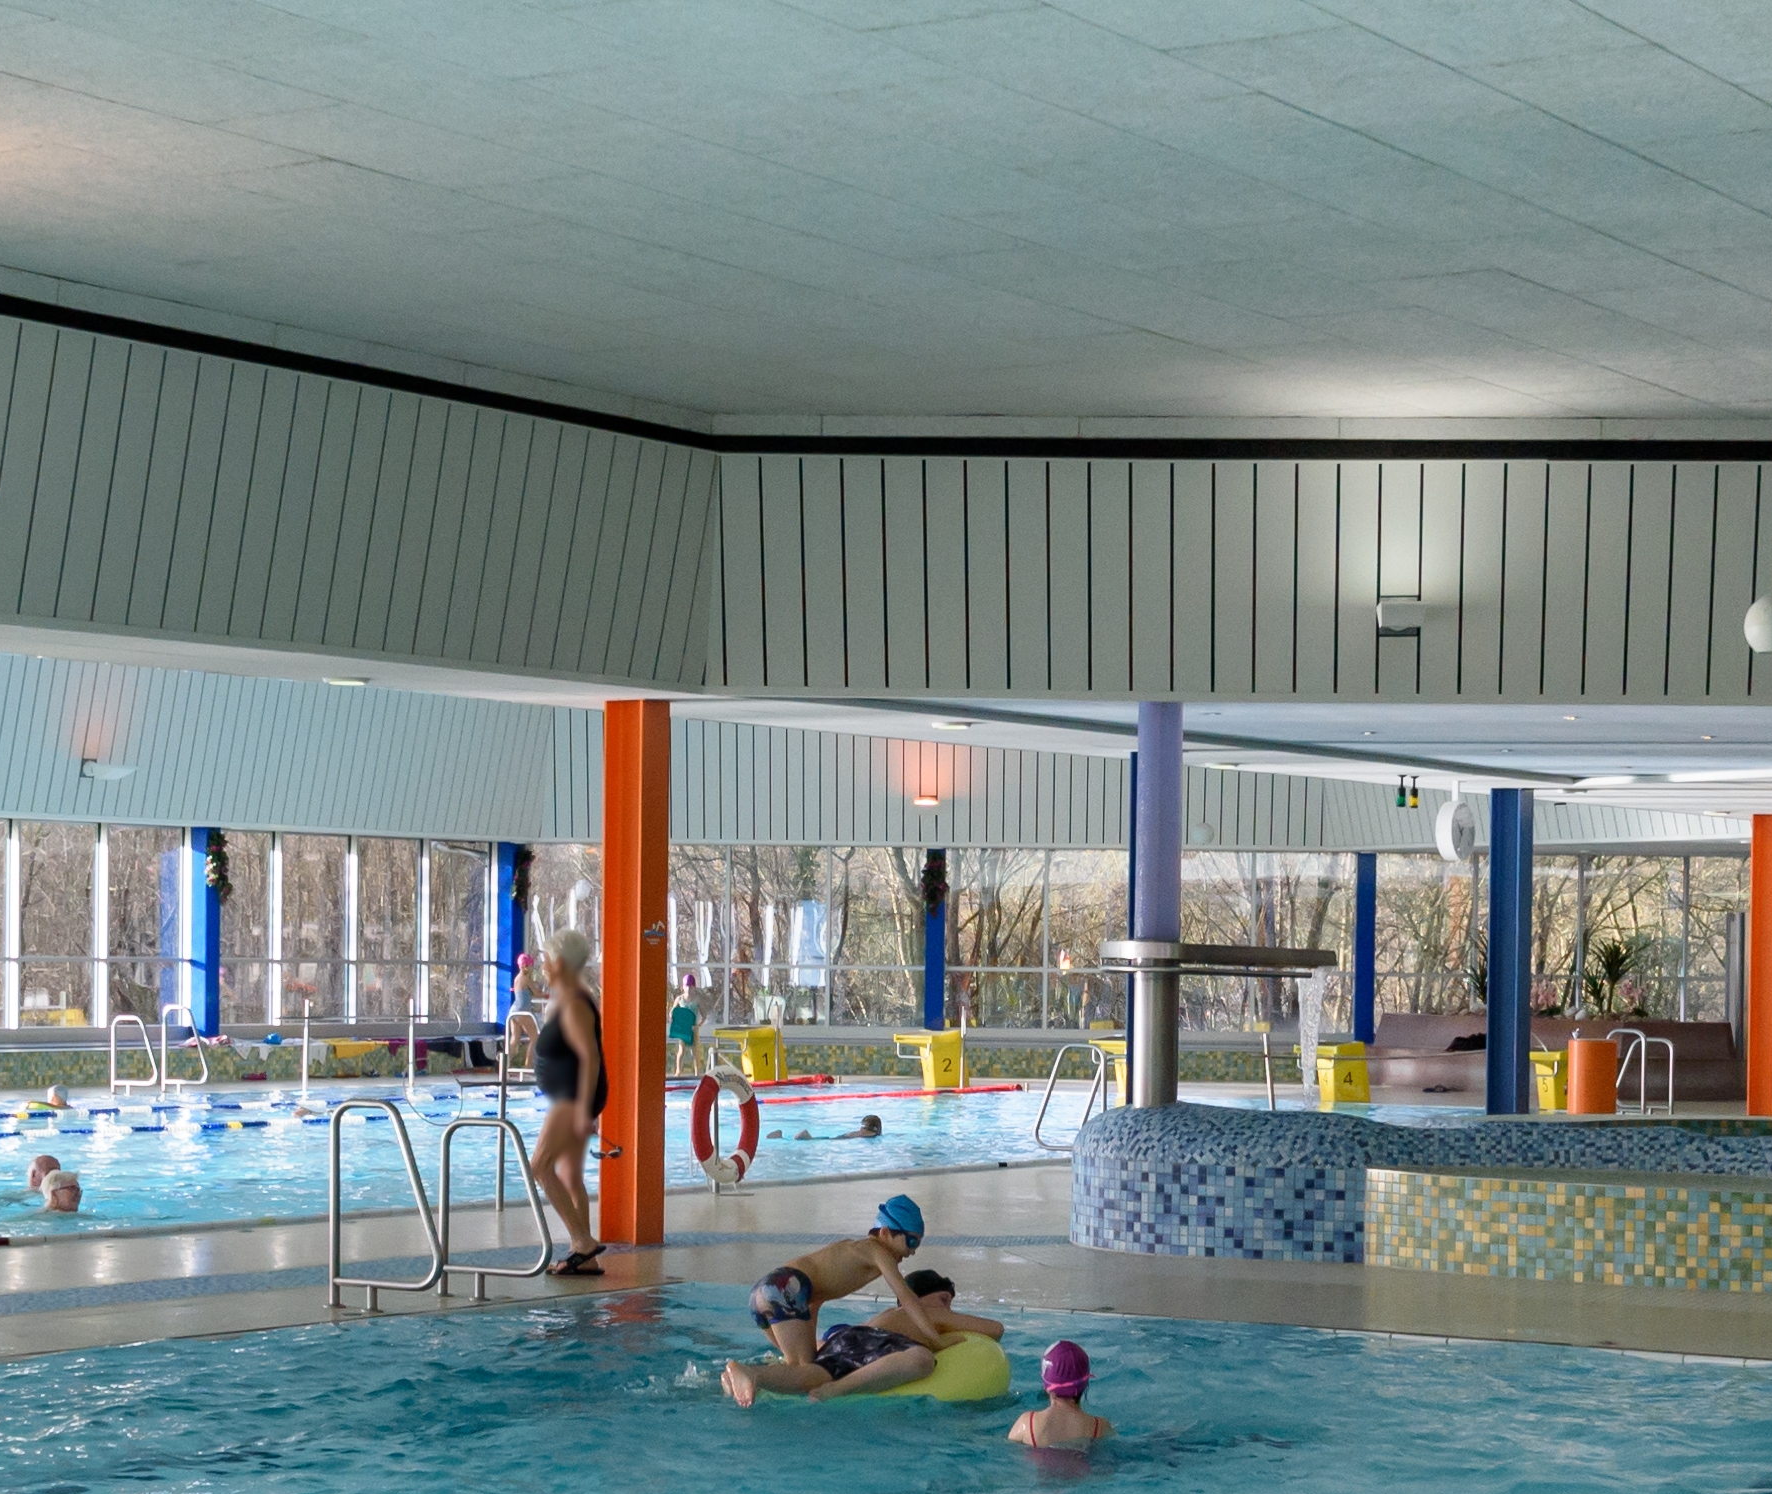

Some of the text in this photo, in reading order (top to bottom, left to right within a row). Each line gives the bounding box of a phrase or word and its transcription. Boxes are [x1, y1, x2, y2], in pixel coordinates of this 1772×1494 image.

[762, 1052, 768, 1066] 1
[942, 1057, 952, 1072] 2
[1343, 1071, 1353, 1086] 4
[1542, 1077, 1549, 1093] 5
